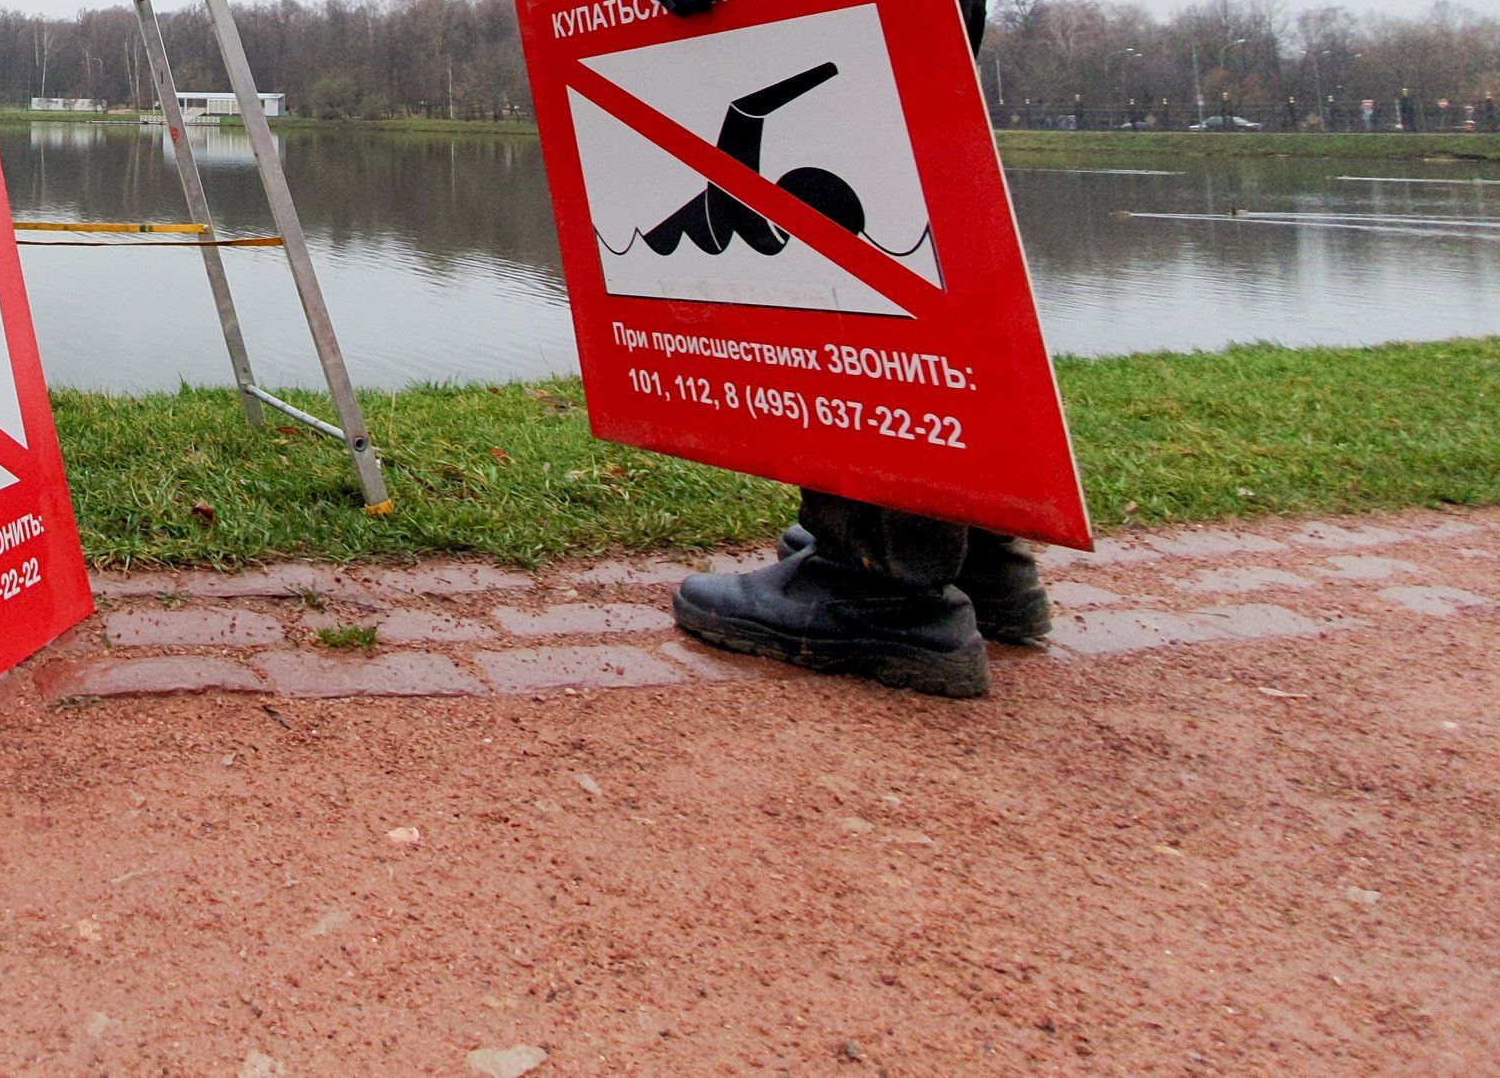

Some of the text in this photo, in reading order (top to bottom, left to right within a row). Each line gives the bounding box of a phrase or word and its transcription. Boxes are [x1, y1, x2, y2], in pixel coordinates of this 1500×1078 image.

[612, 321, 977, 391] При происшествиях ЗВОНИТЬ:
[628, 368, 967, 449] 101, 112, 8 (495) 637-22-22
